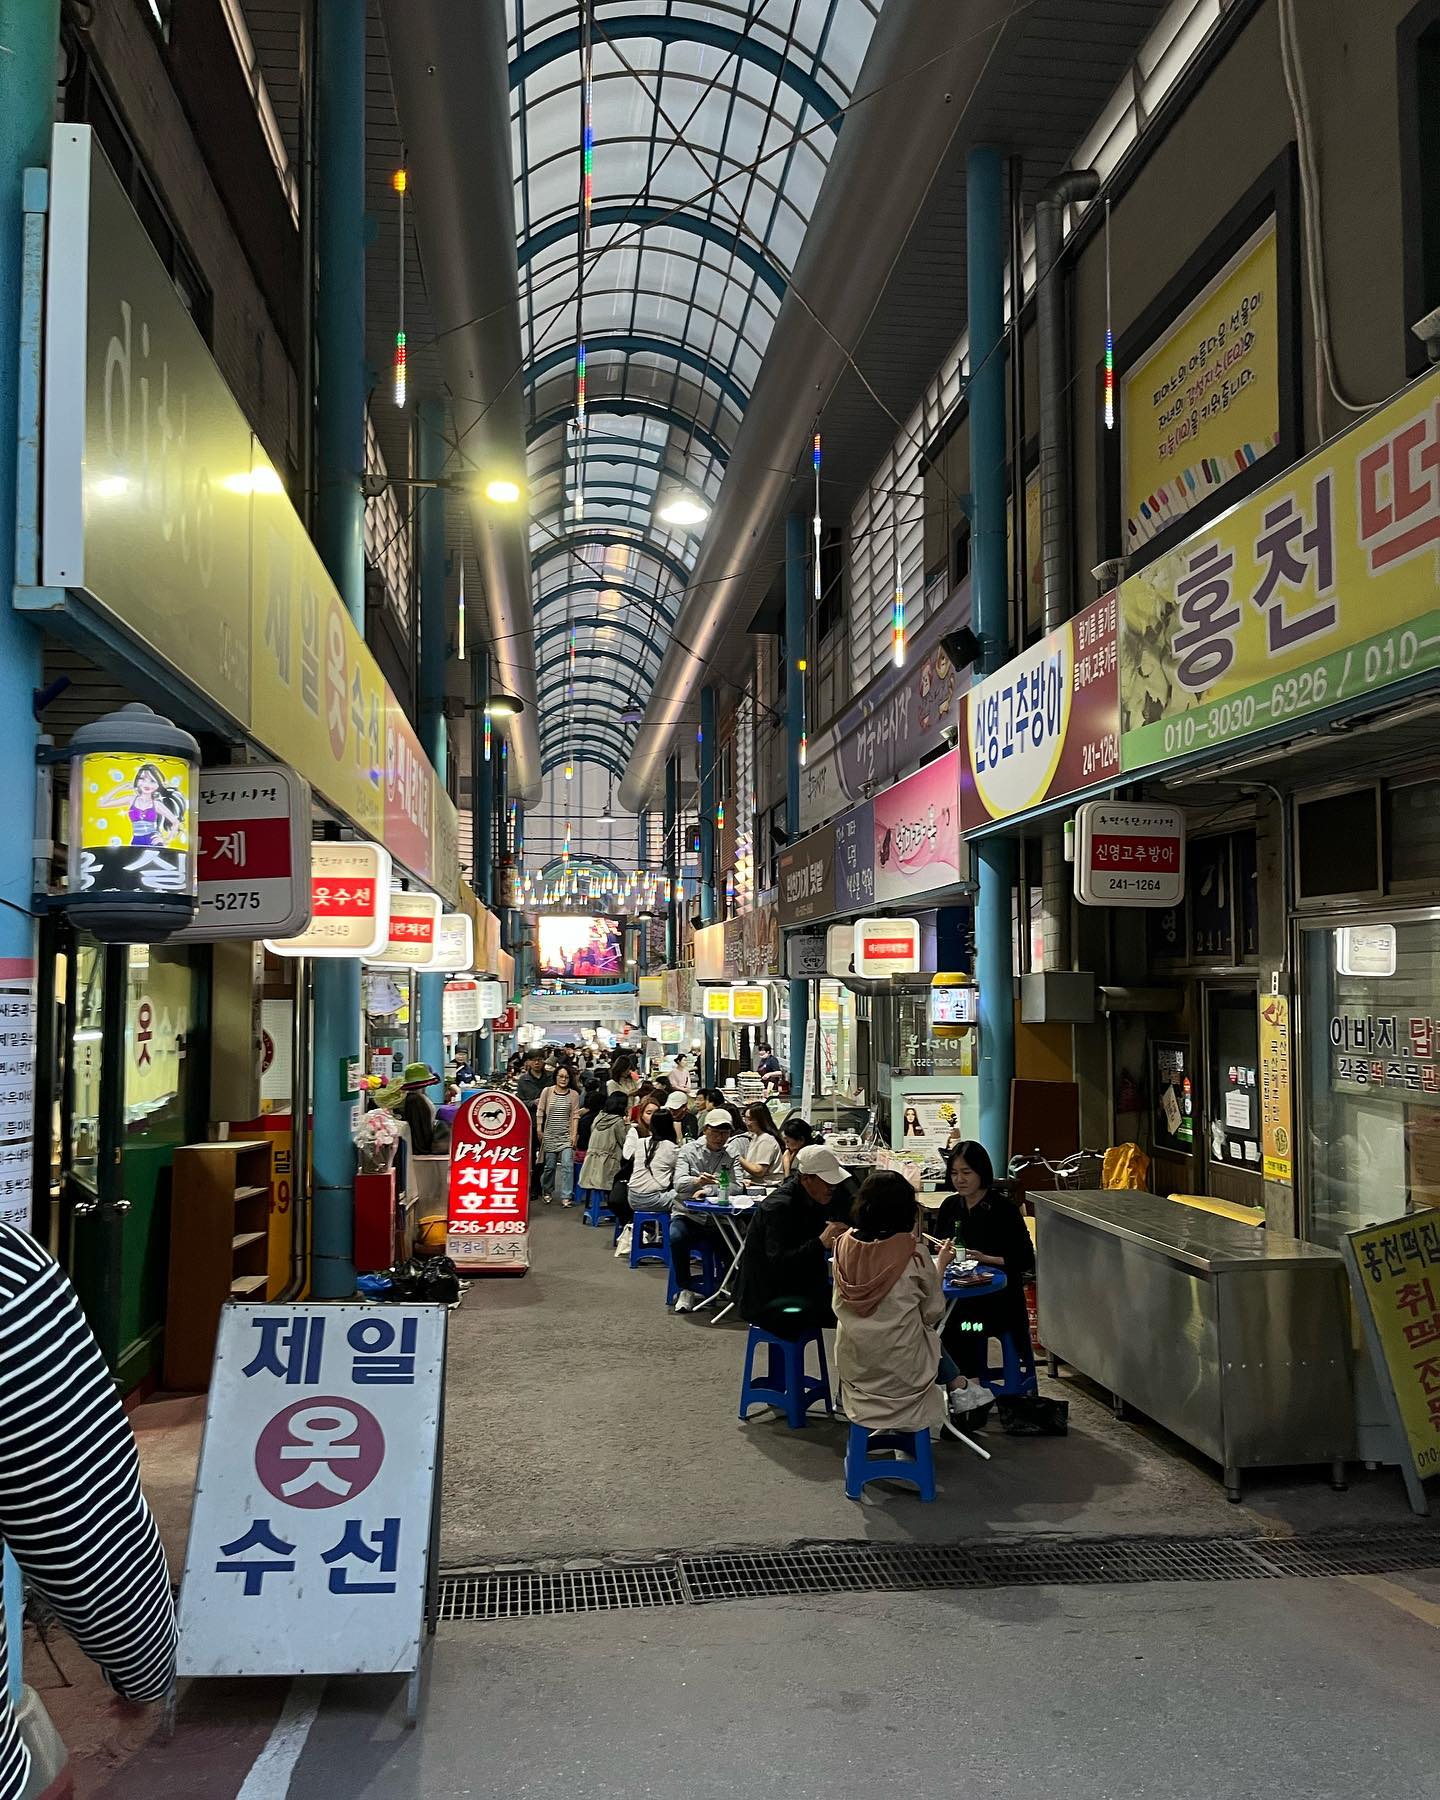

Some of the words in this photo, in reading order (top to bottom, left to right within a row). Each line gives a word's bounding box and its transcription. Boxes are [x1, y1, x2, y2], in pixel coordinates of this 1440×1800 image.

[1153, 366, 1186, 406] 피아노의
[976, 649, 1063, 775] 신영고추방아
[1164, 664, 1327, 753] 010-3030-6326
[1083, 733, 1119, 776] 241-1264
[198, 830, 246, 867] 제
[1096, 844, 1175, 863] 신영고추방아
[312, 887, 370, 907] 옷수선
[1109, 878, 1160, 890] 241-1264
[454, 1140, 525, 1165] 멕시칸
[458, 1167, 519, 1192] 치킨
[456, 1192, 519, 1214] 호프
[449, 1220, 526, 1235] 256-1498
[450, 1240, 485, 1254] 막걸리
[491, 1241, 522, 1260] 소주
[242, 1317, 418, 1384] 제일
[280, 1406, 361, 1497] 옷
[216, 1518, 401, 1596] 수선
